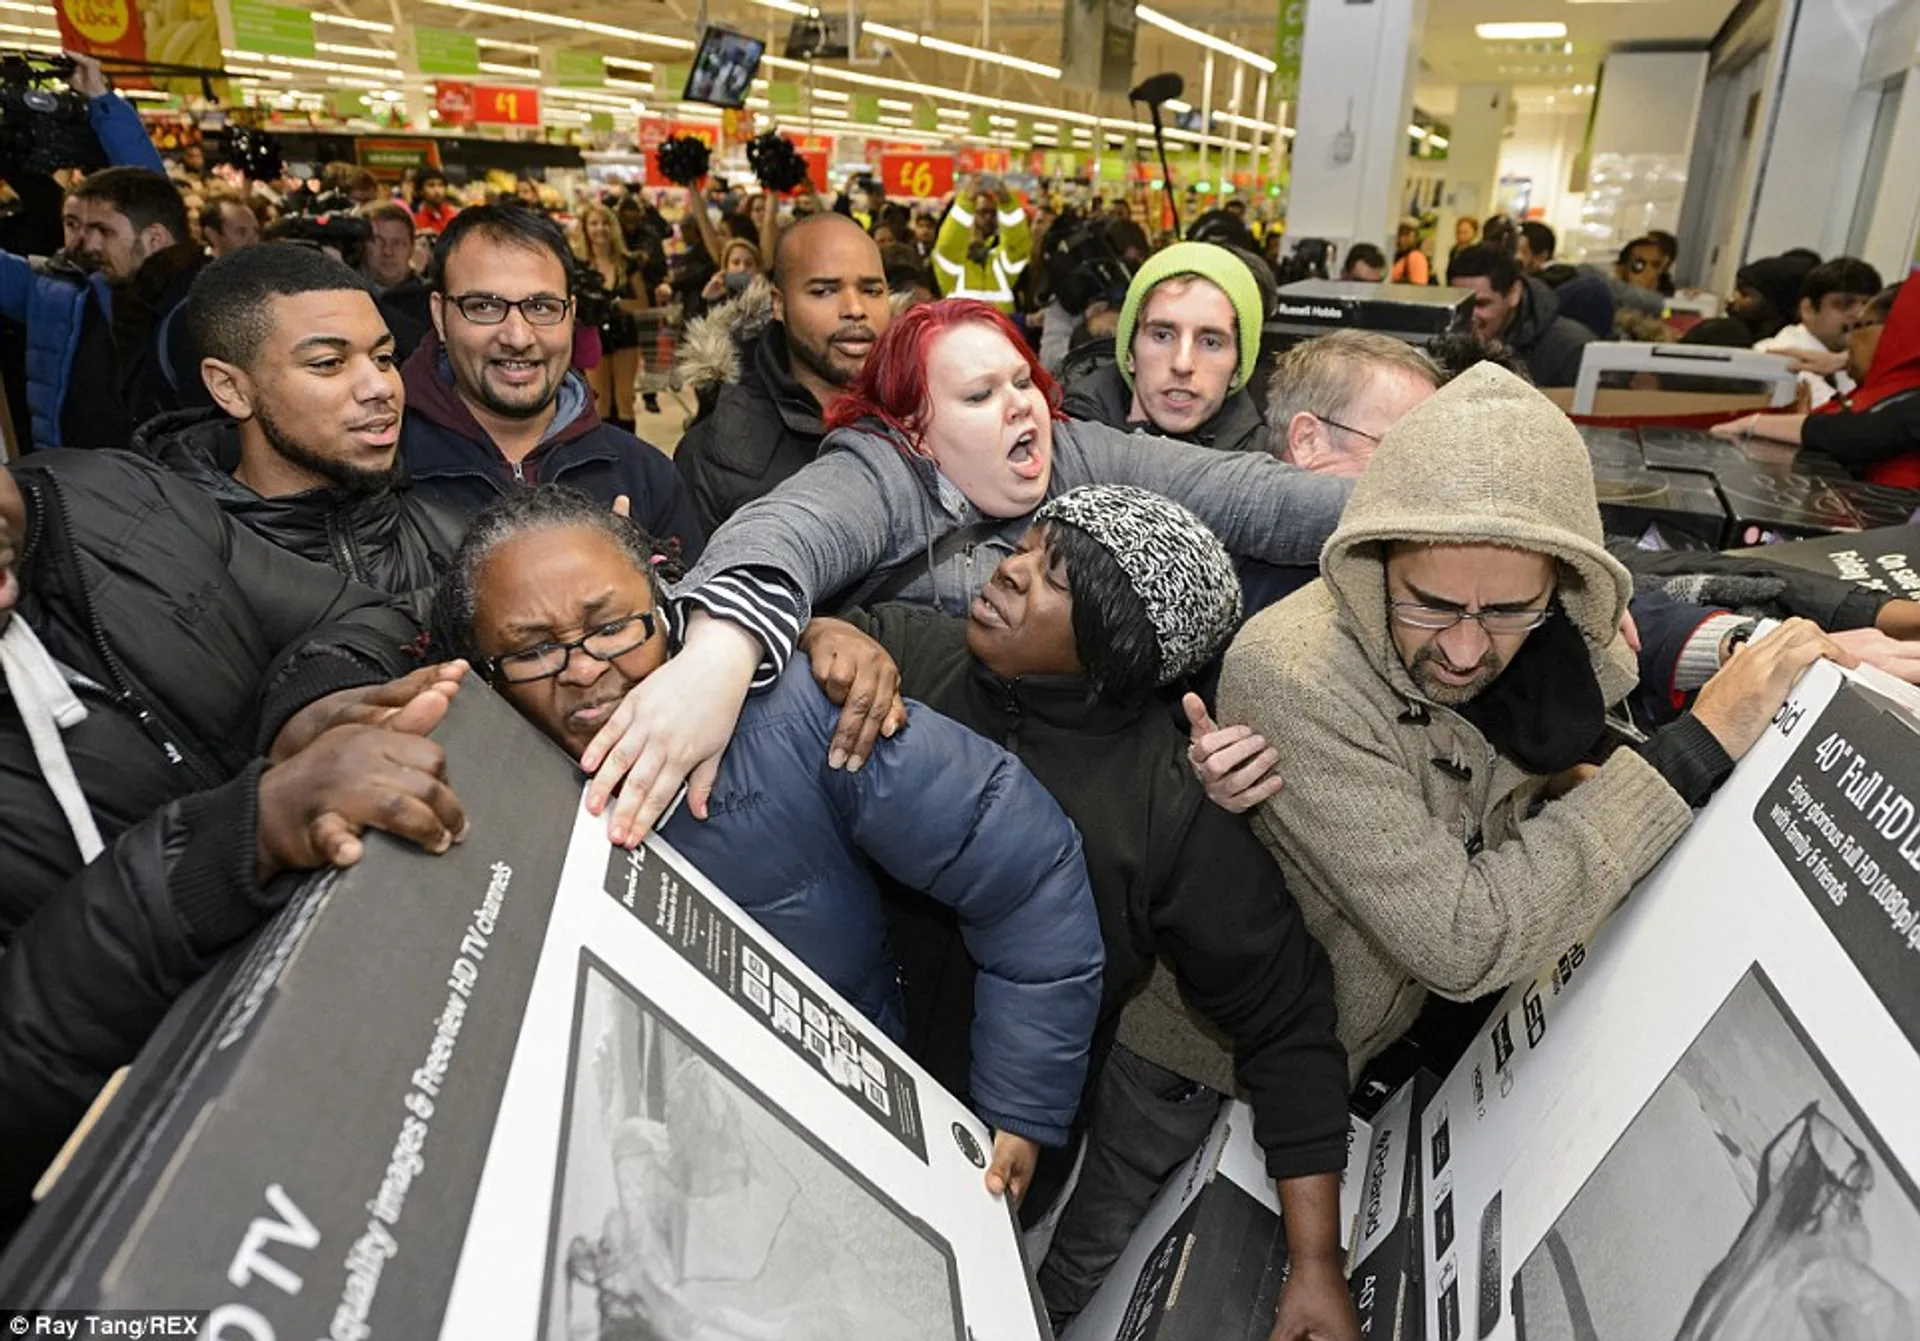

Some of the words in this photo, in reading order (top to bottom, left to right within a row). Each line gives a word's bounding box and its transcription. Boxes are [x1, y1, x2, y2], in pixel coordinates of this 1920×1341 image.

[900, 160, 934, 198] £6
[1814, 732, 1854, 772] 40"
[1836, 754, 1884, 811] Full
[1866, 784, 1915, 841] HD
[473, 860, 513, 936] channels
[1770, 803, 1792, 832] with
[1784, 819, 1813, 862] family
[1812, 857, 1848, 907] friends
[1787, 774, 1814, 813] Enjoy
[1804, 801, 1843, 849] glorious
[1838, 834, 1865, 869] Full
[1854, 854, 1881, 887] HD
[1868, 872, 1920, 936] (1080p)
[447, 957, 480, 999] HD
[460, 924, 490, 962] TV
[411, 991, 468, 1097] Freeview
[365, 1115, 426, 1226] images
[227, 1183, 322, 1297] TV
[330, 1219, 399, 1341] quality
